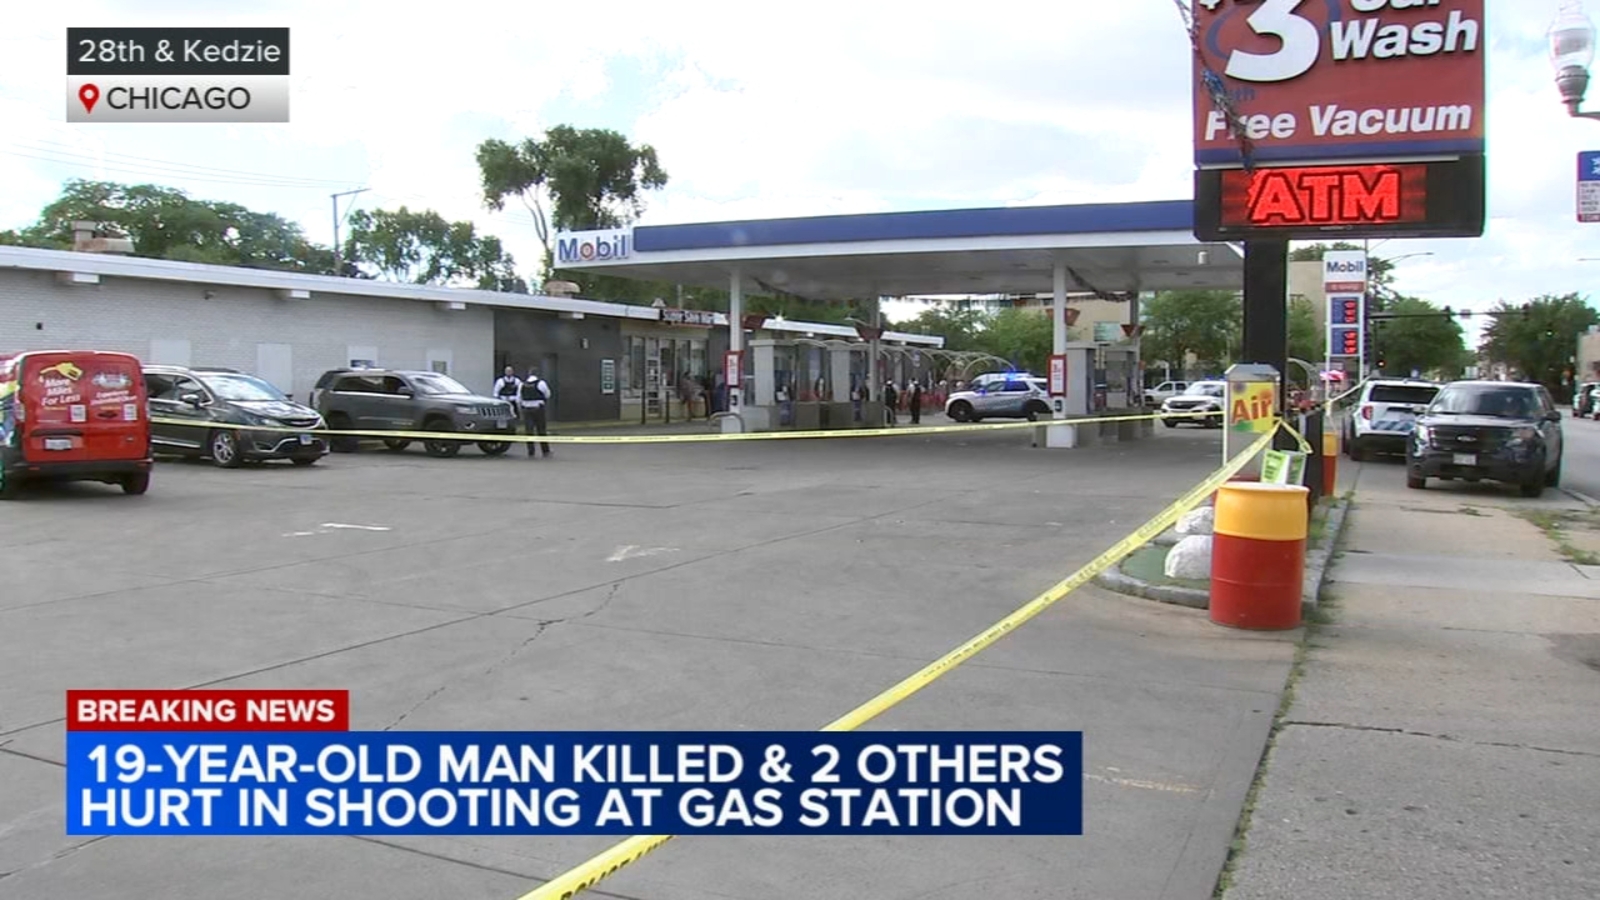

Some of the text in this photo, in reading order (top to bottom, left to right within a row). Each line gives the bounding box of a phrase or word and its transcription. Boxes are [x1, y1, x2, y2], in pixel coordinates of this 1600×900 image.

[1199, 0, 1320, 82] 3
[1331, 10, 1478, 60] Wash
[1309, 104, 1472, 137] Vacuum
[1251, 171, 1400, 222] ATM
[558, 234, 627, 261] Mobil
[1326, 260, 1364, 272] Mobil
[41, 397, 59, 406] For
[60, 394, 81, 404] Less
[1230, 395, 1272, 424] Air
